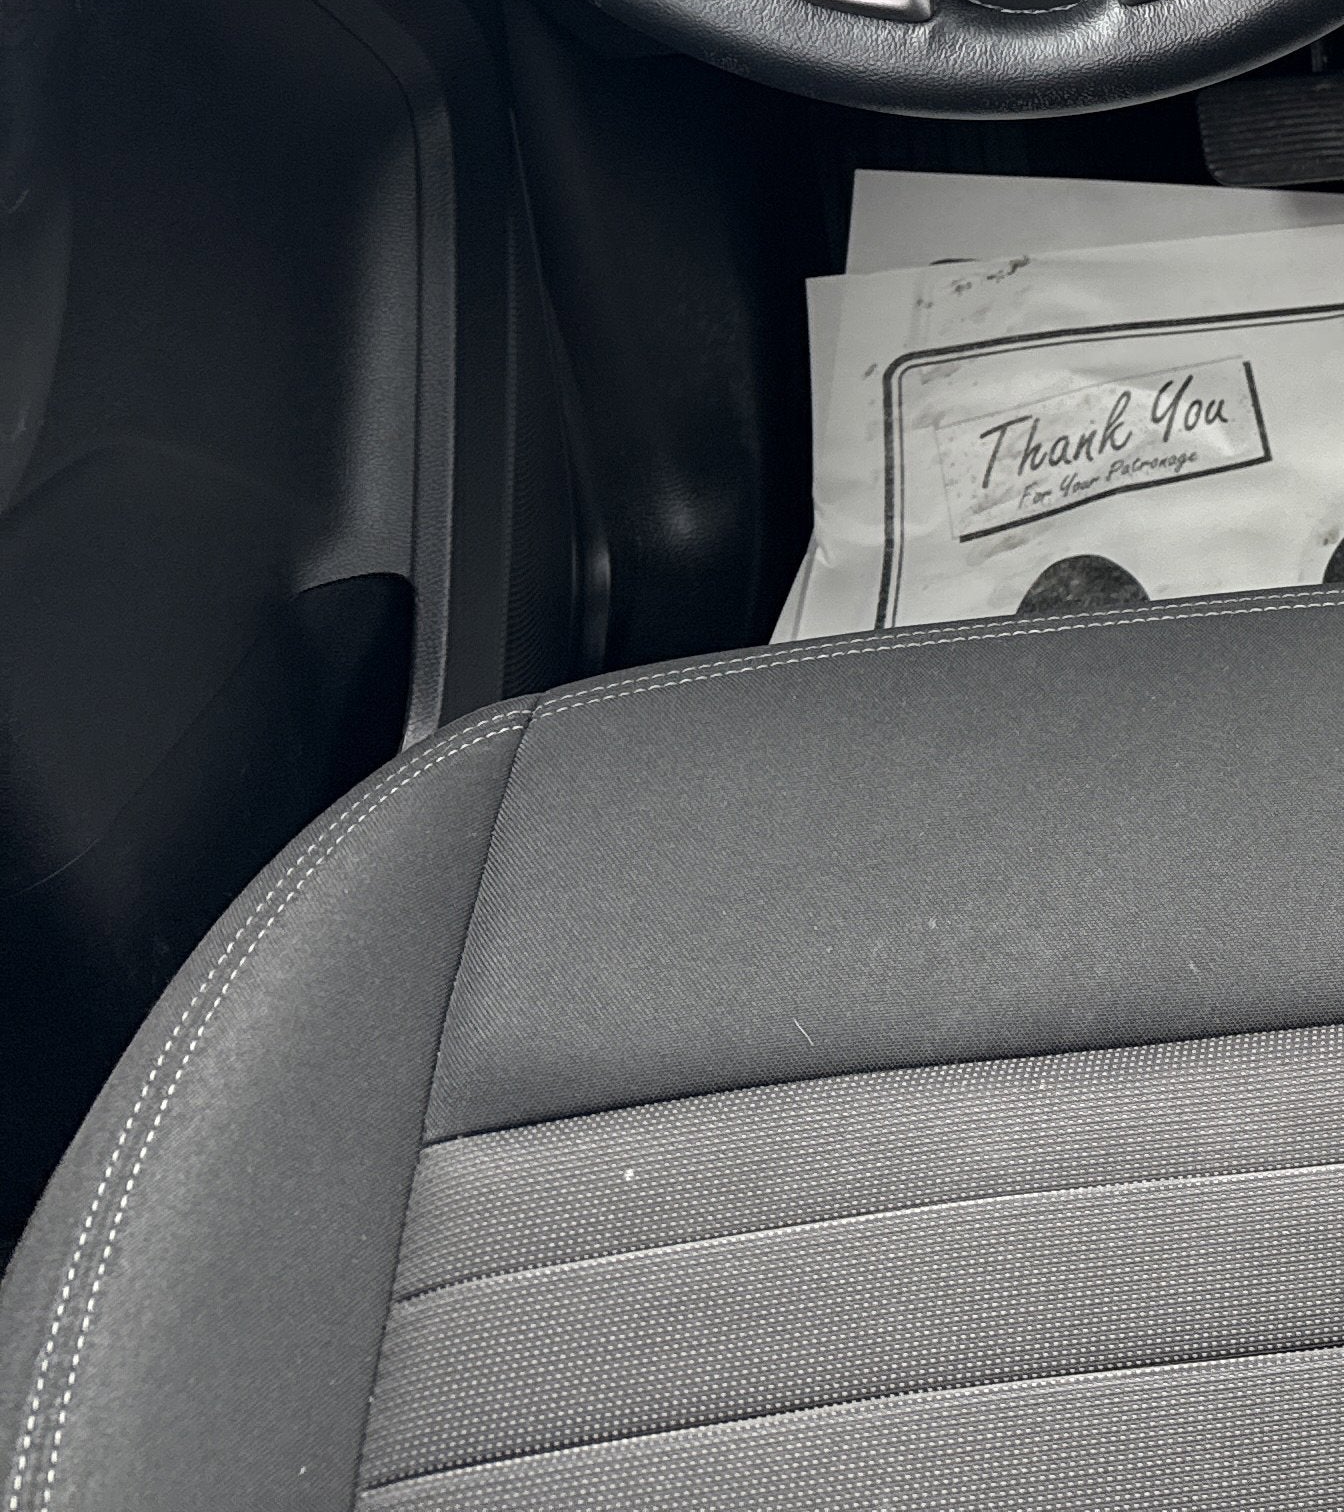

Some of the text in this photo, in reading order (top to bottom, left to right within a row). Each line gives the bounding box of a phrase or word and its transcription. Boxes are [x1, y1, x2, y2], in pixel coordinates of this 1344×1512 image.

[980, 375, 1228, 489] Thank You
[1019, 450, 1198, 509] For Your Patronage
